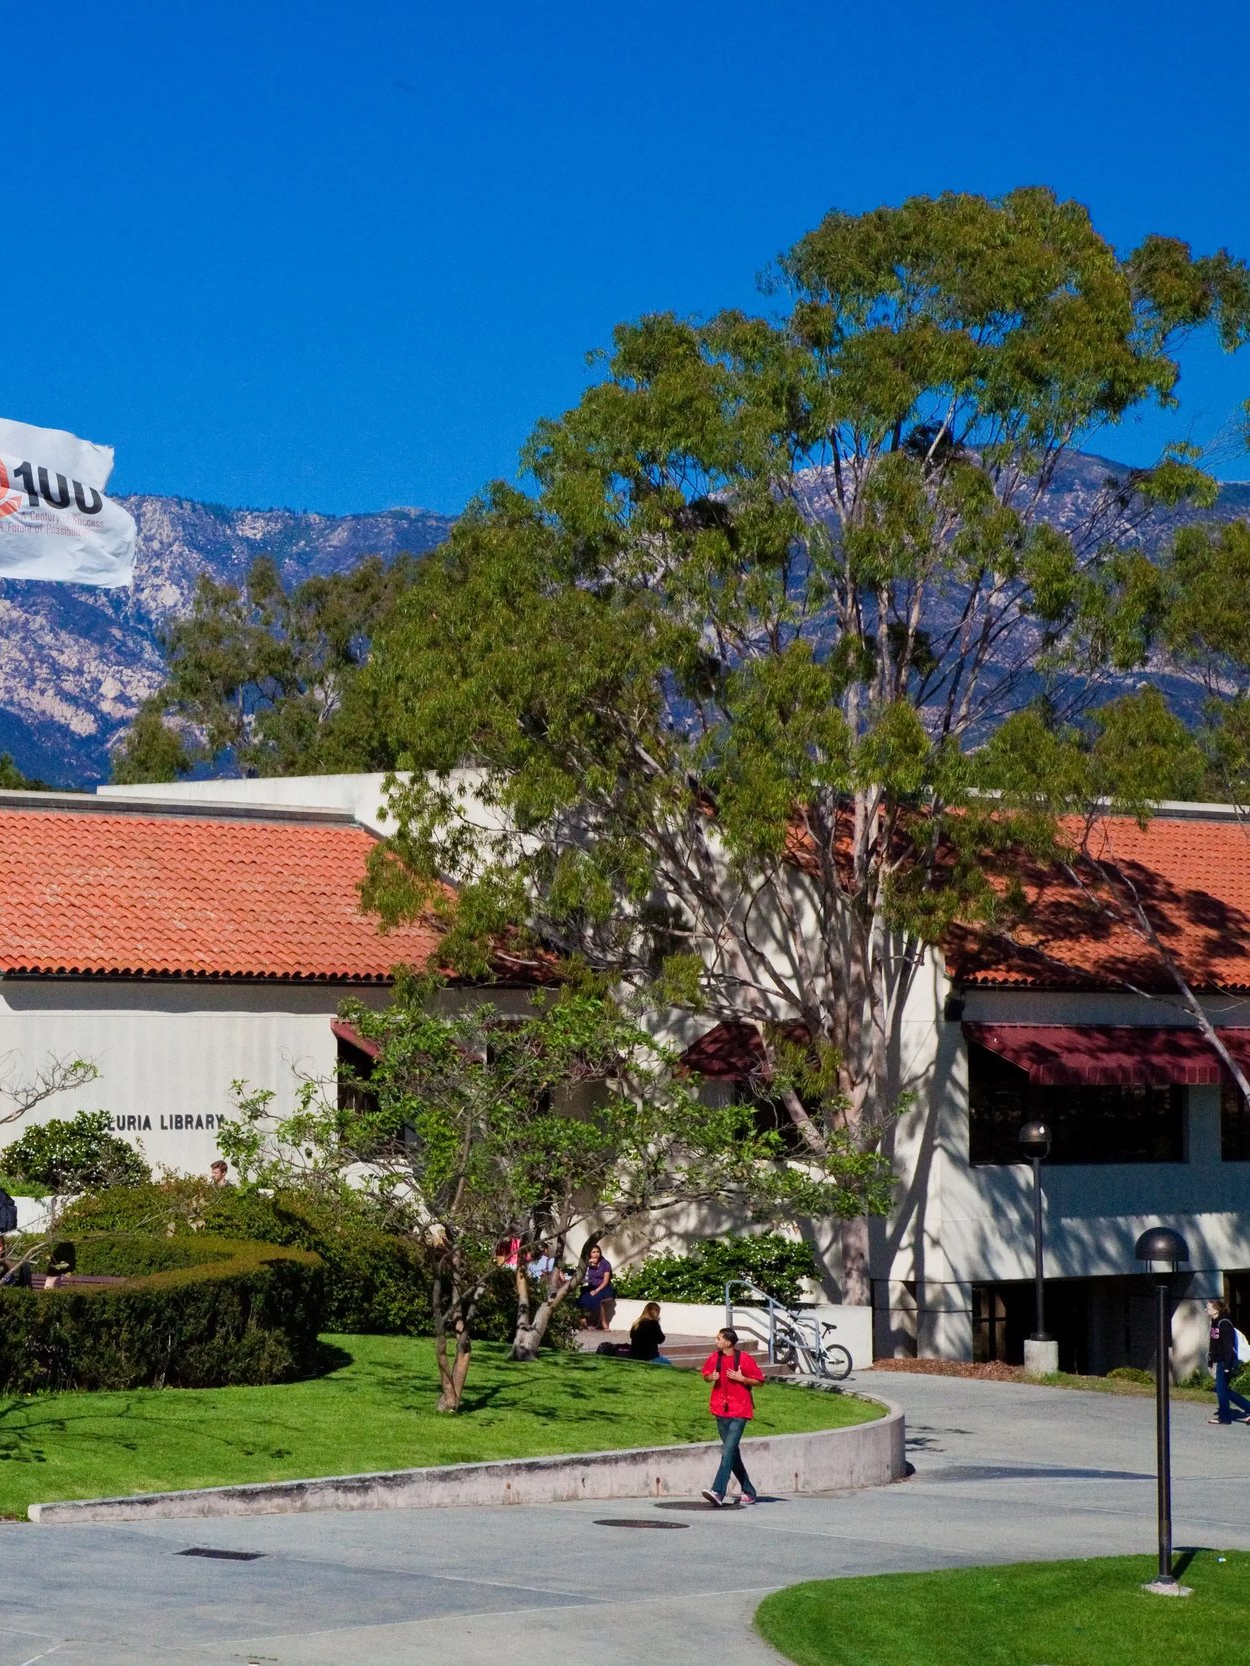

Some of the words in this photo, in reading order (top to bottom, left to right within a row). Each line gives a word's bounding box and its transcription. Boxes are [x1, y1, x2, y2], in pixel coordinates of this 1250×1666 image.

[30, 510, 60, 524] Century
[7, 522, 32, 534] Future
[160, 1114, 225, 1131] LIBRARY
